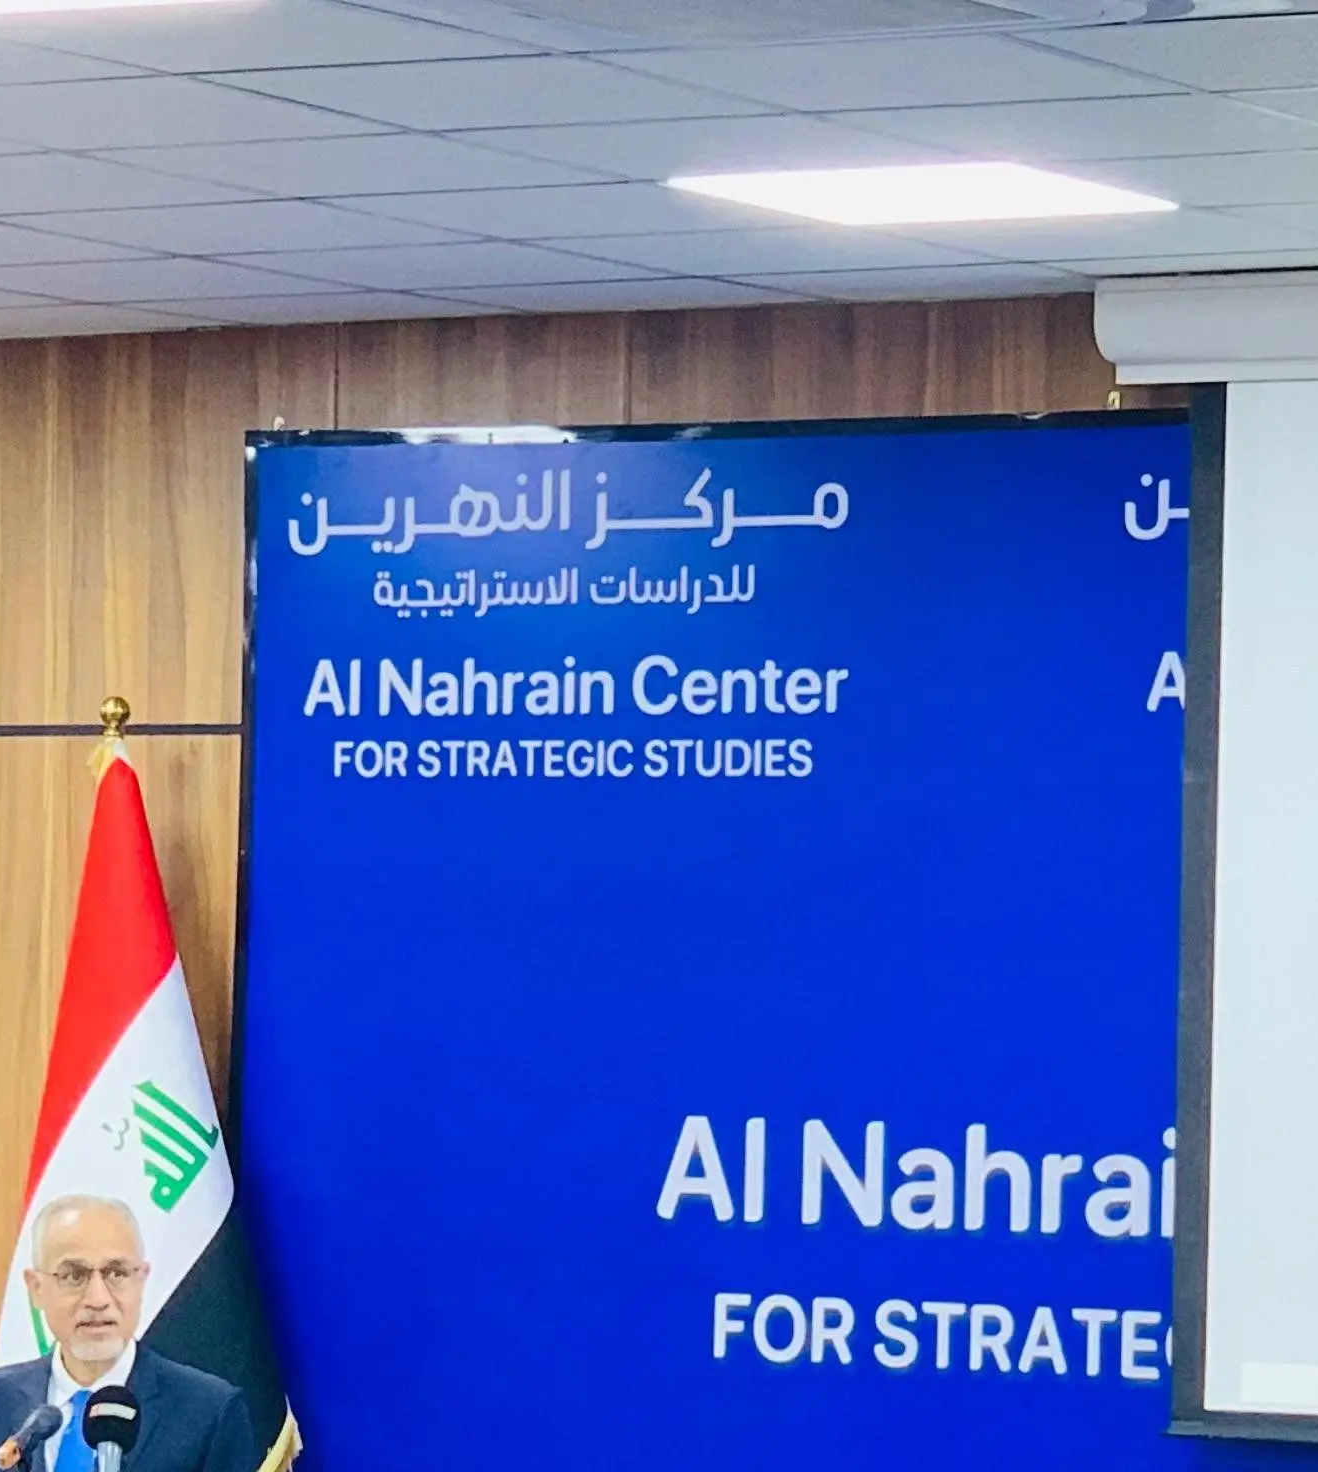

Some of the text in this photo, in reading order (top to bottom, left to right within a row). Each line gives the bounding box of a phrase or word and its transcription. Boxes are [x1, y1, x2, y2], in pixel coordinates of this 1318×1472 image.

[289, 468, 848, 555] مركز النهرين
[374, 565, 754, 617] للدراسات الاستراتيجية
[305, 656, 848, 716] Al Nahrain Center
[1146, 651, 1186, 712] A
[335, 740, 812, 777] FOR STRATEGIC STUDIES
[657, 1116, 1176, 1237] Al Nahrai
[714, 1293, 1172, 1379] FOR STRATE
